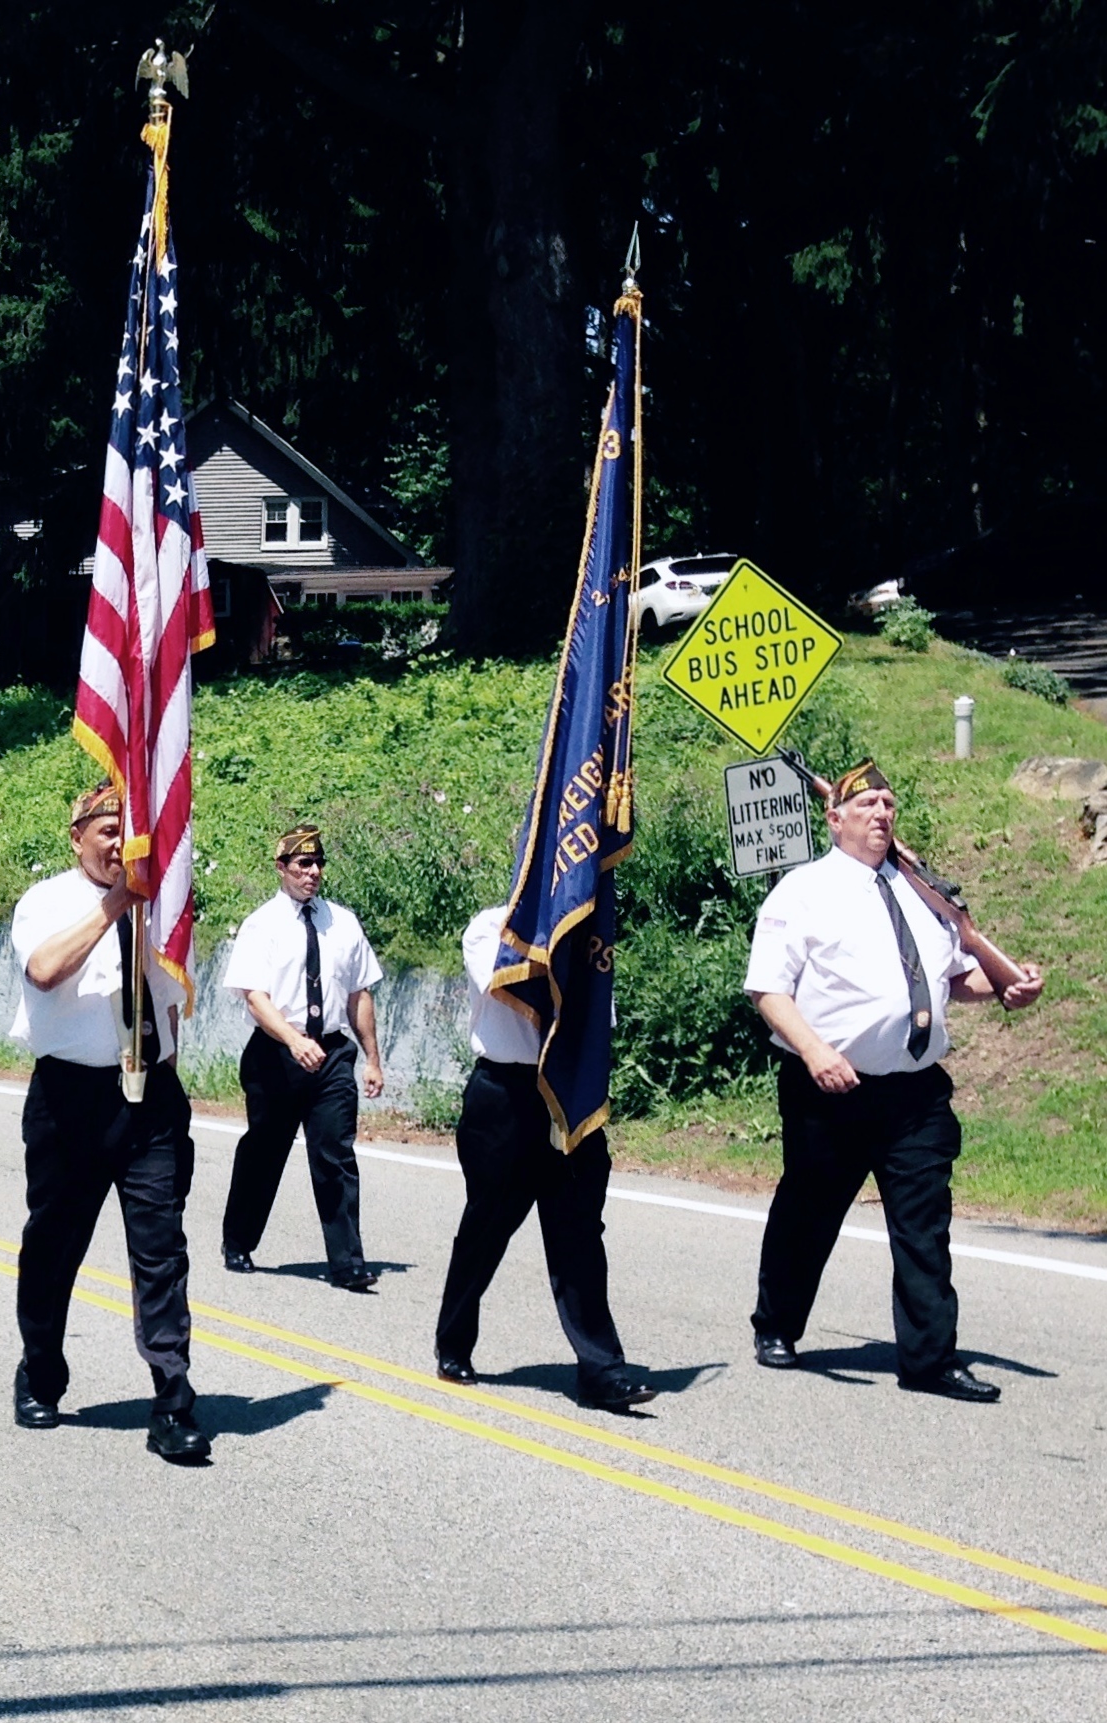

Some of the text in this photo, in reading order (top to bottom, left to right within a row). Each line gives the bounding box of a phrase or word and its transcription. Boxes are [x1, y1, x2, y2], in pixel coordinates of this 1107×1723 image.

[704, 606, 797, 646] SCHOOL
[688, 637, 816, 683] BUS STOP
[719, 674, 797, 712] AHEAD
[749, 766, 776, 791] NO
[731, 792, 803, 826] LITTERING
[735, 820, 803, 849] MAX $500
[756, 843, 787, 865] FINE
